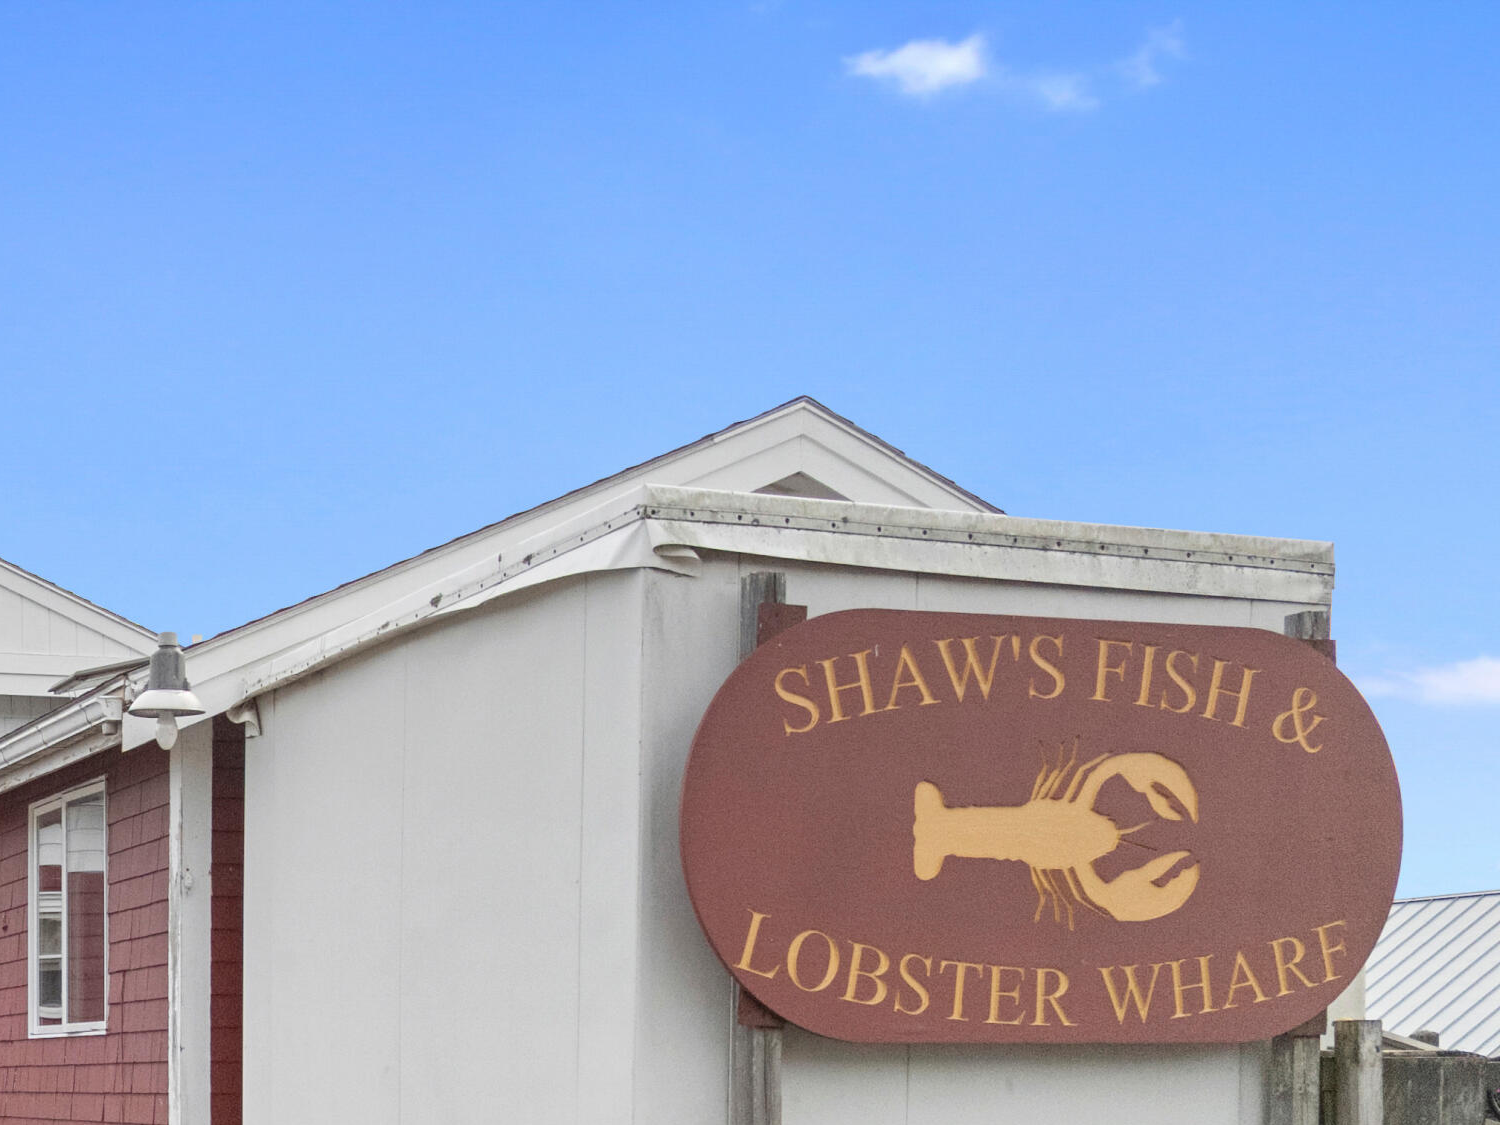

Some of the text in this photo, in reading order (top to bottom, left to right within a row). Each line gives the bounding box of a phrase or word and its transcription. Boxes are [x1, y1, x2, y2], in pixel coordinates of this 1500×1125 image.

[772, 633, 1328, 754] SHAW'S FISH &
[733, 908, 1350, 1027] LOBSTER WHARF
